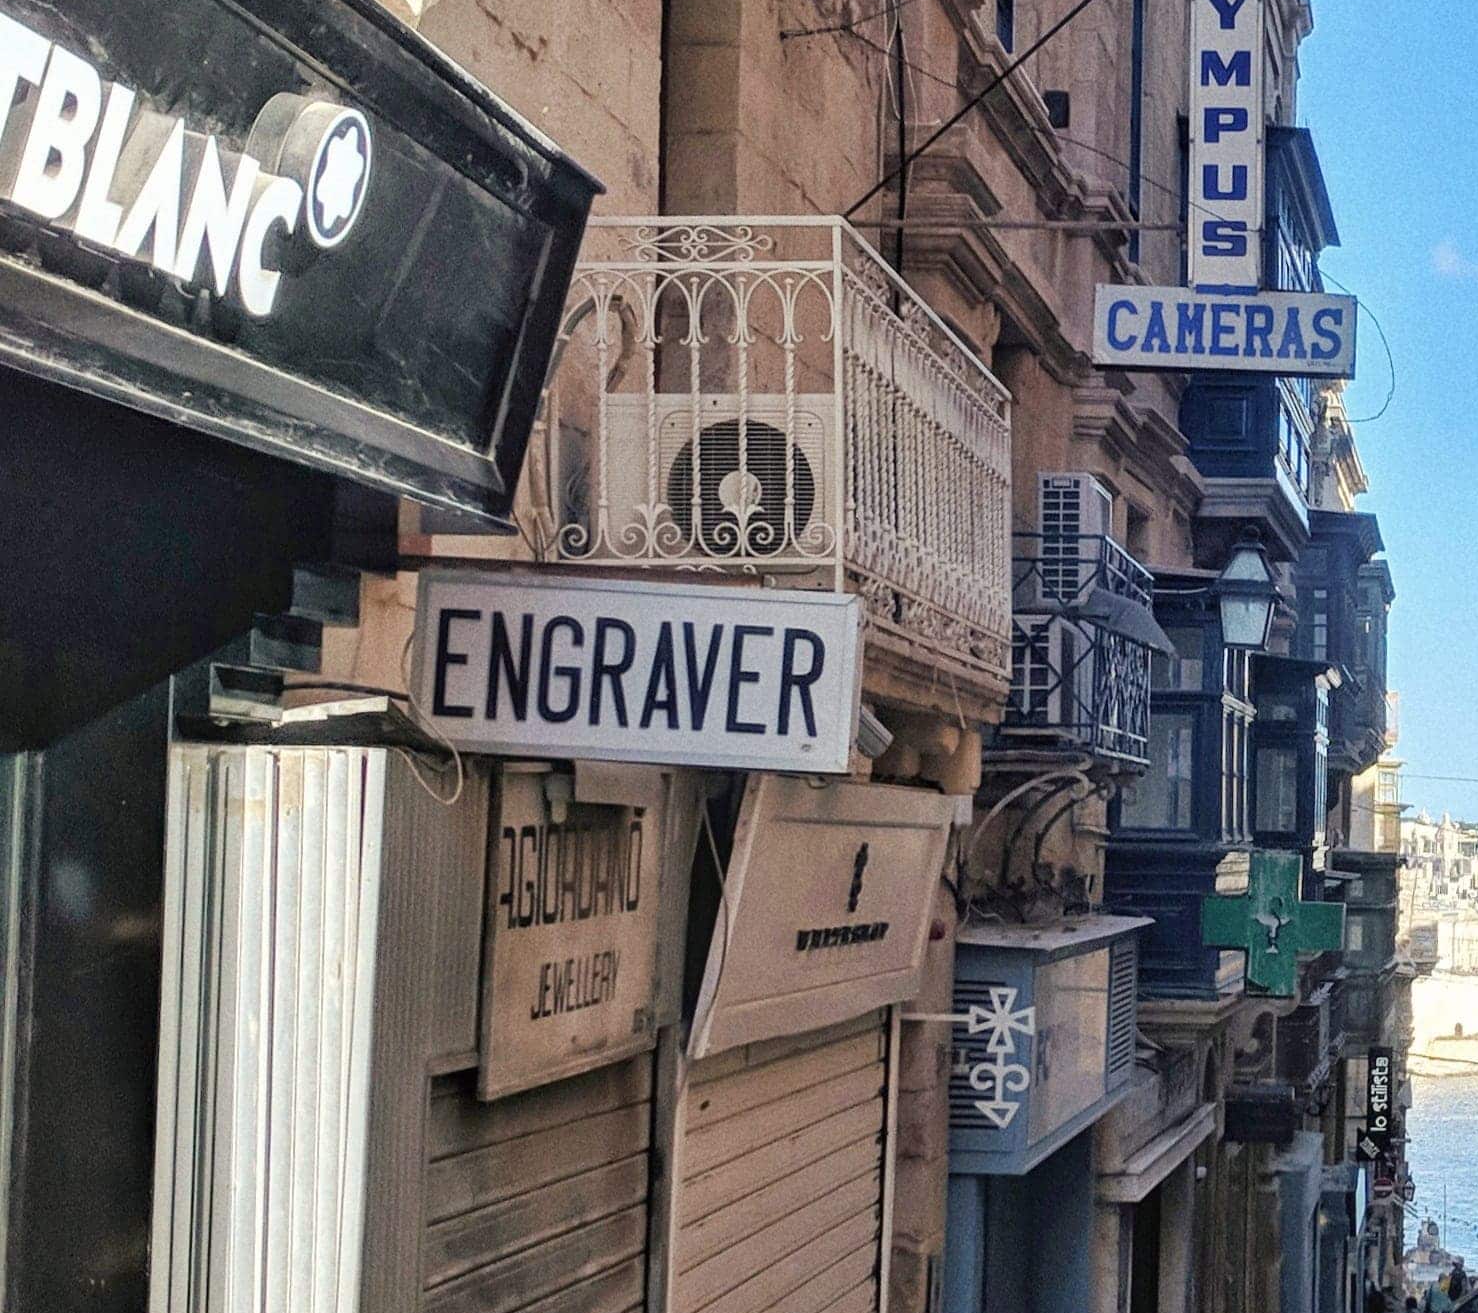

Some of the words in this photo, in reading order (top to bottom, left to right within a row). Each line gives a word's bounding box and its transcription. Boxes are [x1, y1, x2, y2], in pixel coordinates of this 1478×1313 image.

[1107, 299, 1343, 360] CAMERAS
[431, 608, 827, 738] ENGRAVER
[530, 948, 621, 1021] JEWELLERY
